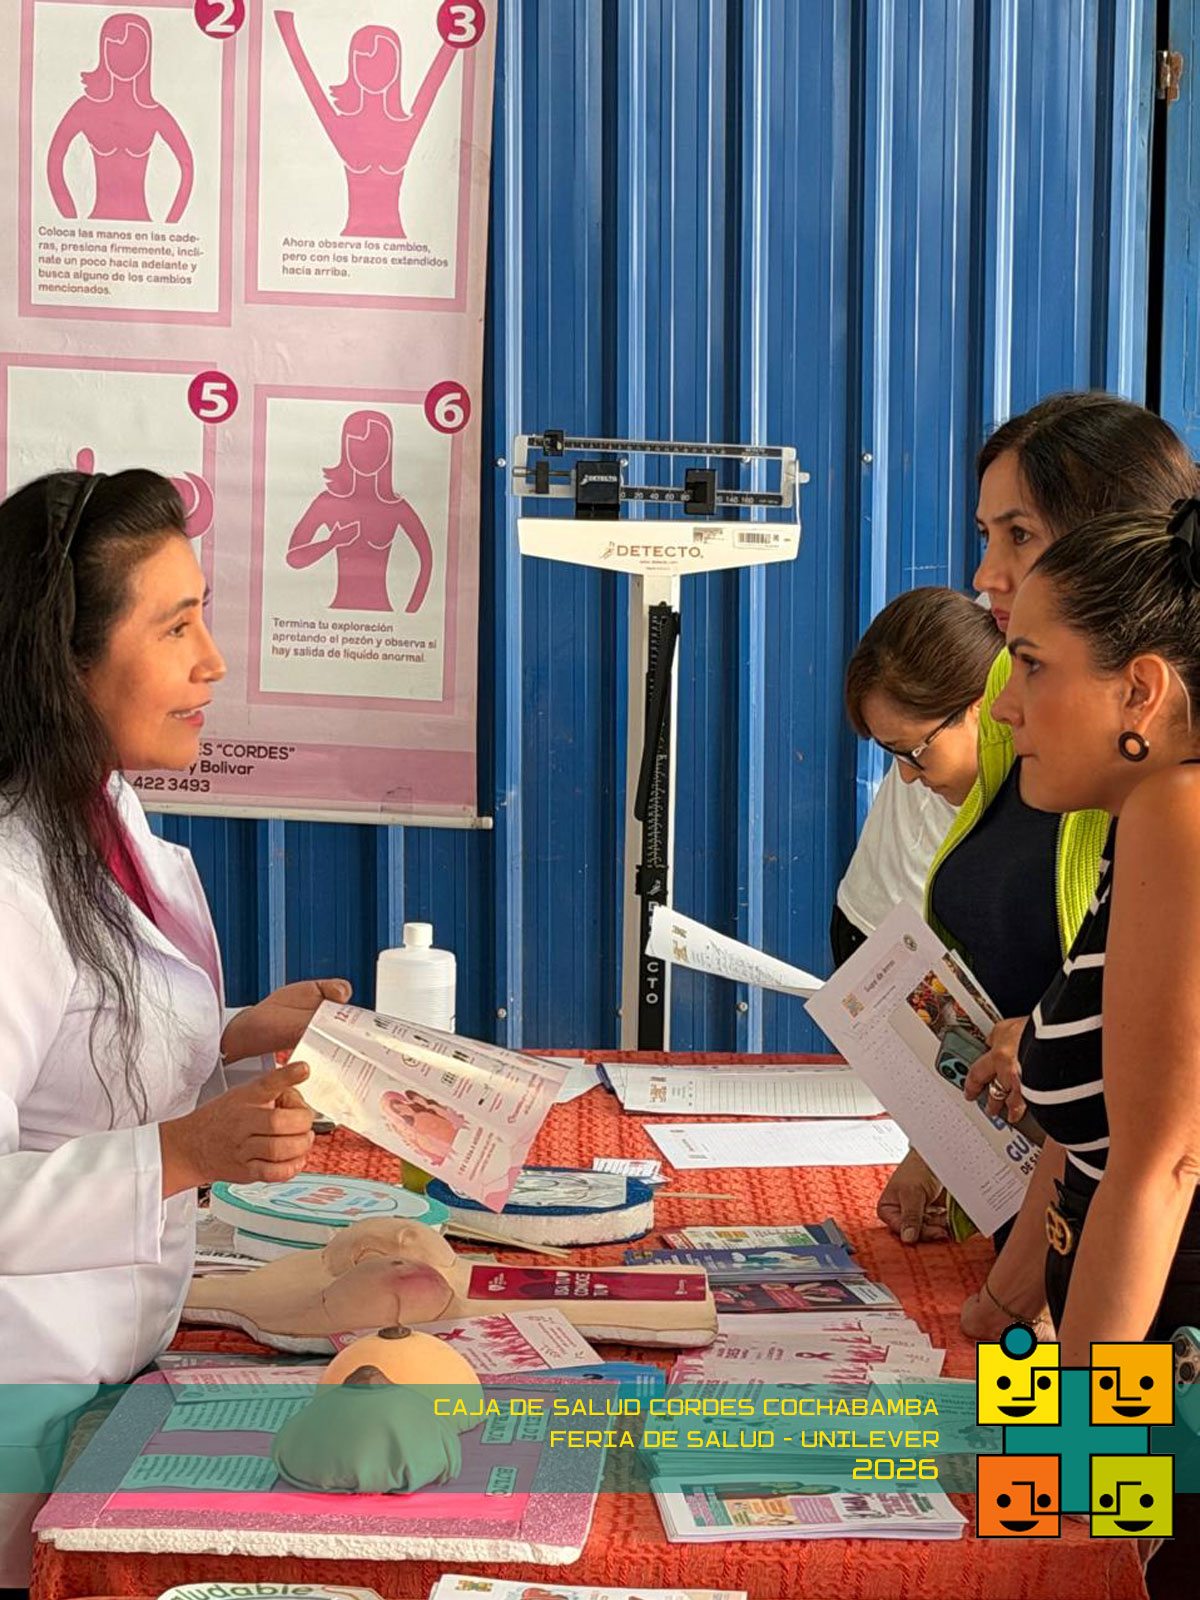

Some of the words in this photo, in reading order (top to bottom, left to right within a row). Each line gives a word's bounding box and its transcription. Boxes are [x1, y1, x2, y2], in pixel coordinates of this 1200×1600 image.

[205, 0, 235, 33] 2
[447, 5, 477, 42] 3
[38, 226, 76, 237] Coloca
[78, 228, 93, 238] las
[96, 230, 132, 240] manos
[135, 232, 148, 241] en
[151, 231, 166, 242] las
[169, 232, 200, 243] cade-
[38, 242, 58, 252] ras,
[61, 242, 107, 254] presiona
[110, 243, 175, 256] firmemente,
[282, 237, 315, 248] Ahora
[318, 238, 361, 250] observa
[364, 240, 380, 250] los
[383, 241, 431, 253] cambios,
[38, 254, 61, 264] nate
[64, 256, 77, 265] un
[80, 258, 107, 268] poco
[142, 259, 188, 270] adelante
[190, 262, 197, 272] y
[282, 252, 307, 262] pero
[310, 253, 330, 262] con
[333, 252, 349, 263] los
[351, 253, 388, 264] brazos
[390, 255, 449, 267] extendidos
[38, 268, 70, 279] busca
[73, 270, 109, 282] alguno
[112, 271, 125, 281] de
[128, 272, 143, 283] los
[146, 273, 192, 284] cambios
[199, 382, 230, 418] 5
[434, 392, 464, 428] 6
[634, 492, 644, 500] 20
[649, 493, 659, 501] 40
[665, 493, 675, 501] 60
[680, 493, 690, 502] 80
[616, 545, 701, 558] DETECTO
[272, 617, 316, 629] Termina
[318, 620, 329, 630] tu
[331, 620, 394, 633] exploración
[272, 631, 327, 644] apretando
[329, 633, 339, 643] el
[341, 635, 373, 646] pezón
[376, 637, 383, 648] y
[385, 636, 426, 649] observa
[428, 639, 437, 649] si
[271, 644, 291, 658] hay
[293, 646, 324, 657] salida
[327, 647, 341, 658] de
[200, 760, 254, 775] Bolivar
[133, 776, 165, 791] 422
[168, 777, 211, 793] 3493
[1019, 1161, 1034, 1175] DE
